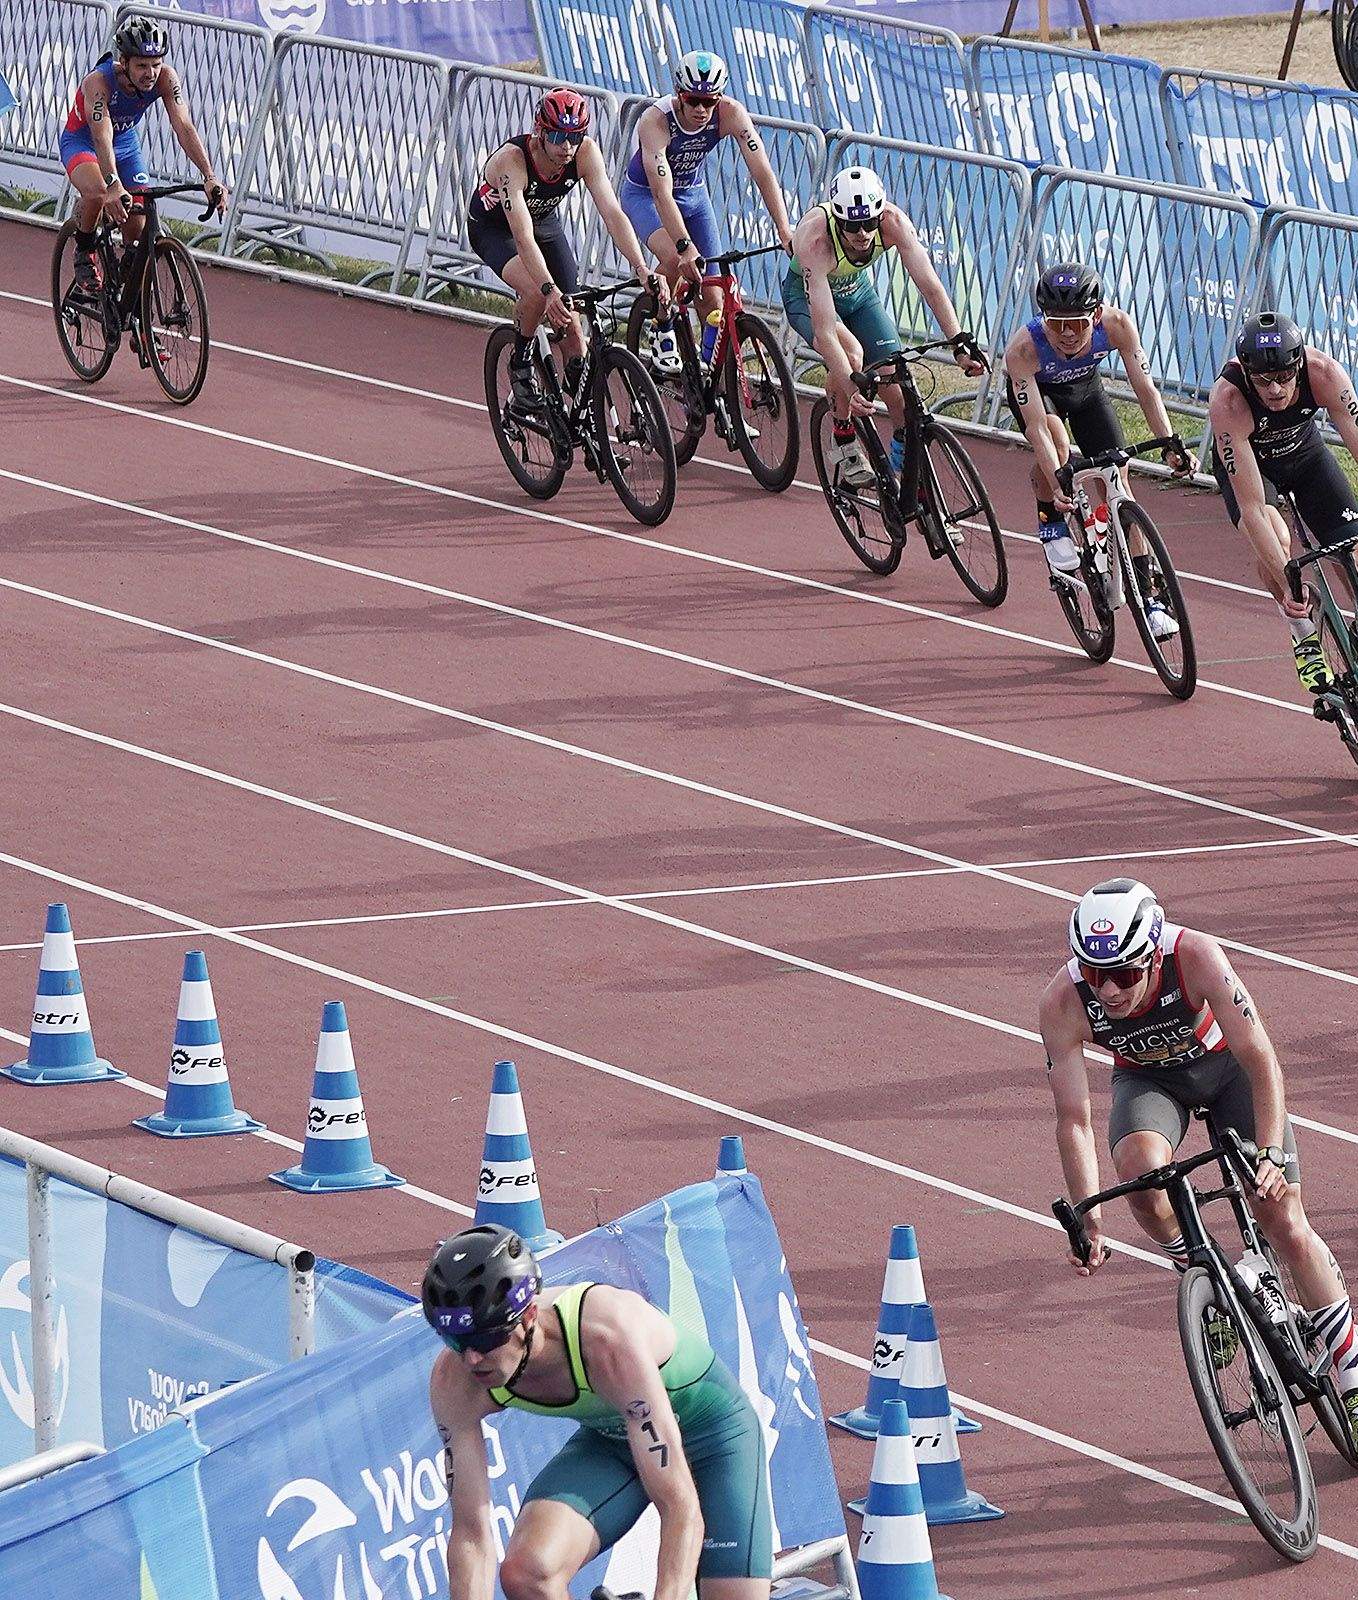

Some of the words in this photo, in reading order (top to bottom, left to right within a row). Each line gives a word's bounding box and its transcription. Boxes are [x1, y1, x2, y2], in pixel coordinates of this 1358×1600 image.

[92, 100, 104, 122] 20
[746, 139, 759, 152] 6
[656, 165, 666, 177] 6
[502, 187, 512, 212] 14
[1259, 335, 1270, 344] 24
[1140, 362, 1151, 376] 9
[1017, 391, 1029, 406] 9
[1222, 447, 1237, 476] 24
[1088, 940, 1100, 951] 41
[1233, 987, 1256, 1026] 41
[1127, 1017, 1181, 1040] HARREITHER
[1116, 1024, 1197, 1057] FUCHS
[515, 1286, 527, 1303] 17
[439, 1314, 452, 1326] 17
[641, 1420, 669, 1468] 17
